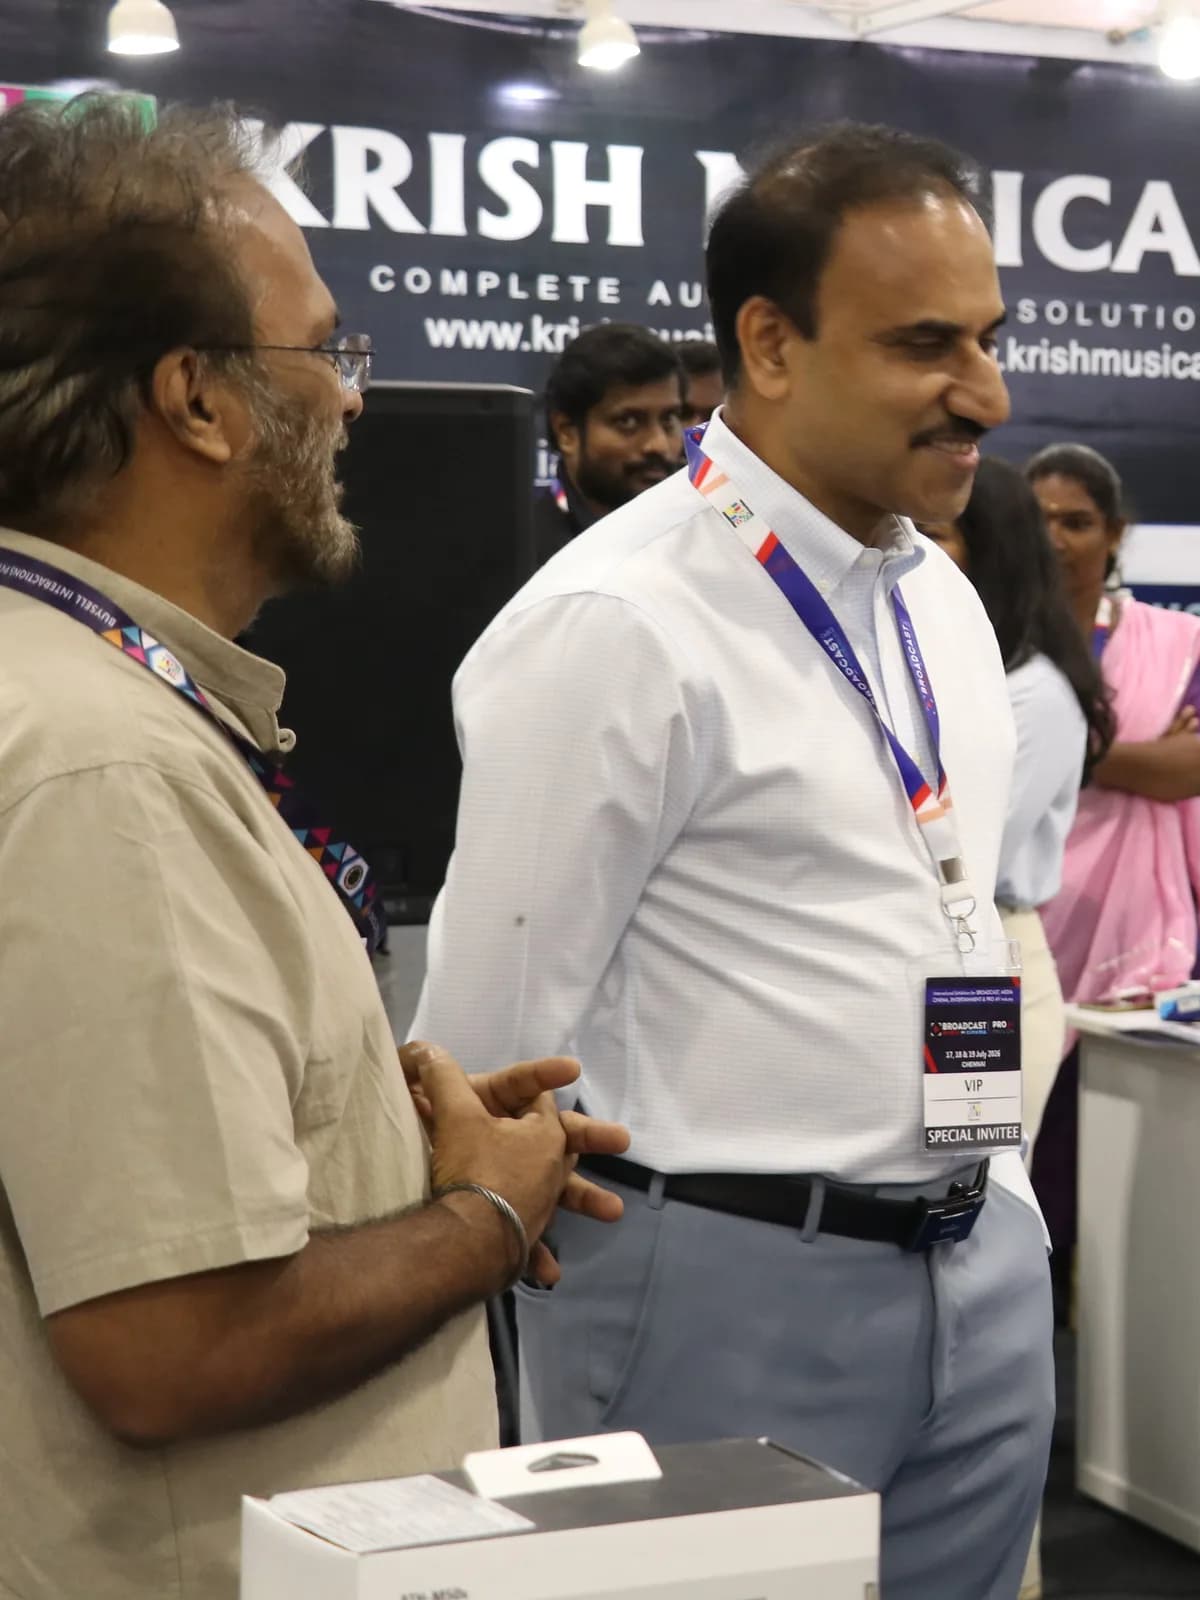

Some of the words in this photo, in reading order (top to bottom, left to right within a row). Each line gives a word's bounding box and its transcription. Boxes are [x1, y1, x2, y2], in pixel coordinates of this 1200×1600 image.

[238, 117, 645, 246] KRISH
[369, 263, 621, 305] COMPLETE
[9, 565, 74, 601] INTERACTIONS
[75, 594, 117, 627] BUYSELL
[823, 636, 877, 706] OADCAST
[902, 622, 929, 696] BROADCAST
[942, 1021, 987, 1031] BROADCAST
[992, 1020, 1007, 1029] PRO
[964, 1079, 983, 1092] VIP
[927, 1128, 974, 1143] SPECIAL
[976, 1125, 1019, 1141] INVITEE
